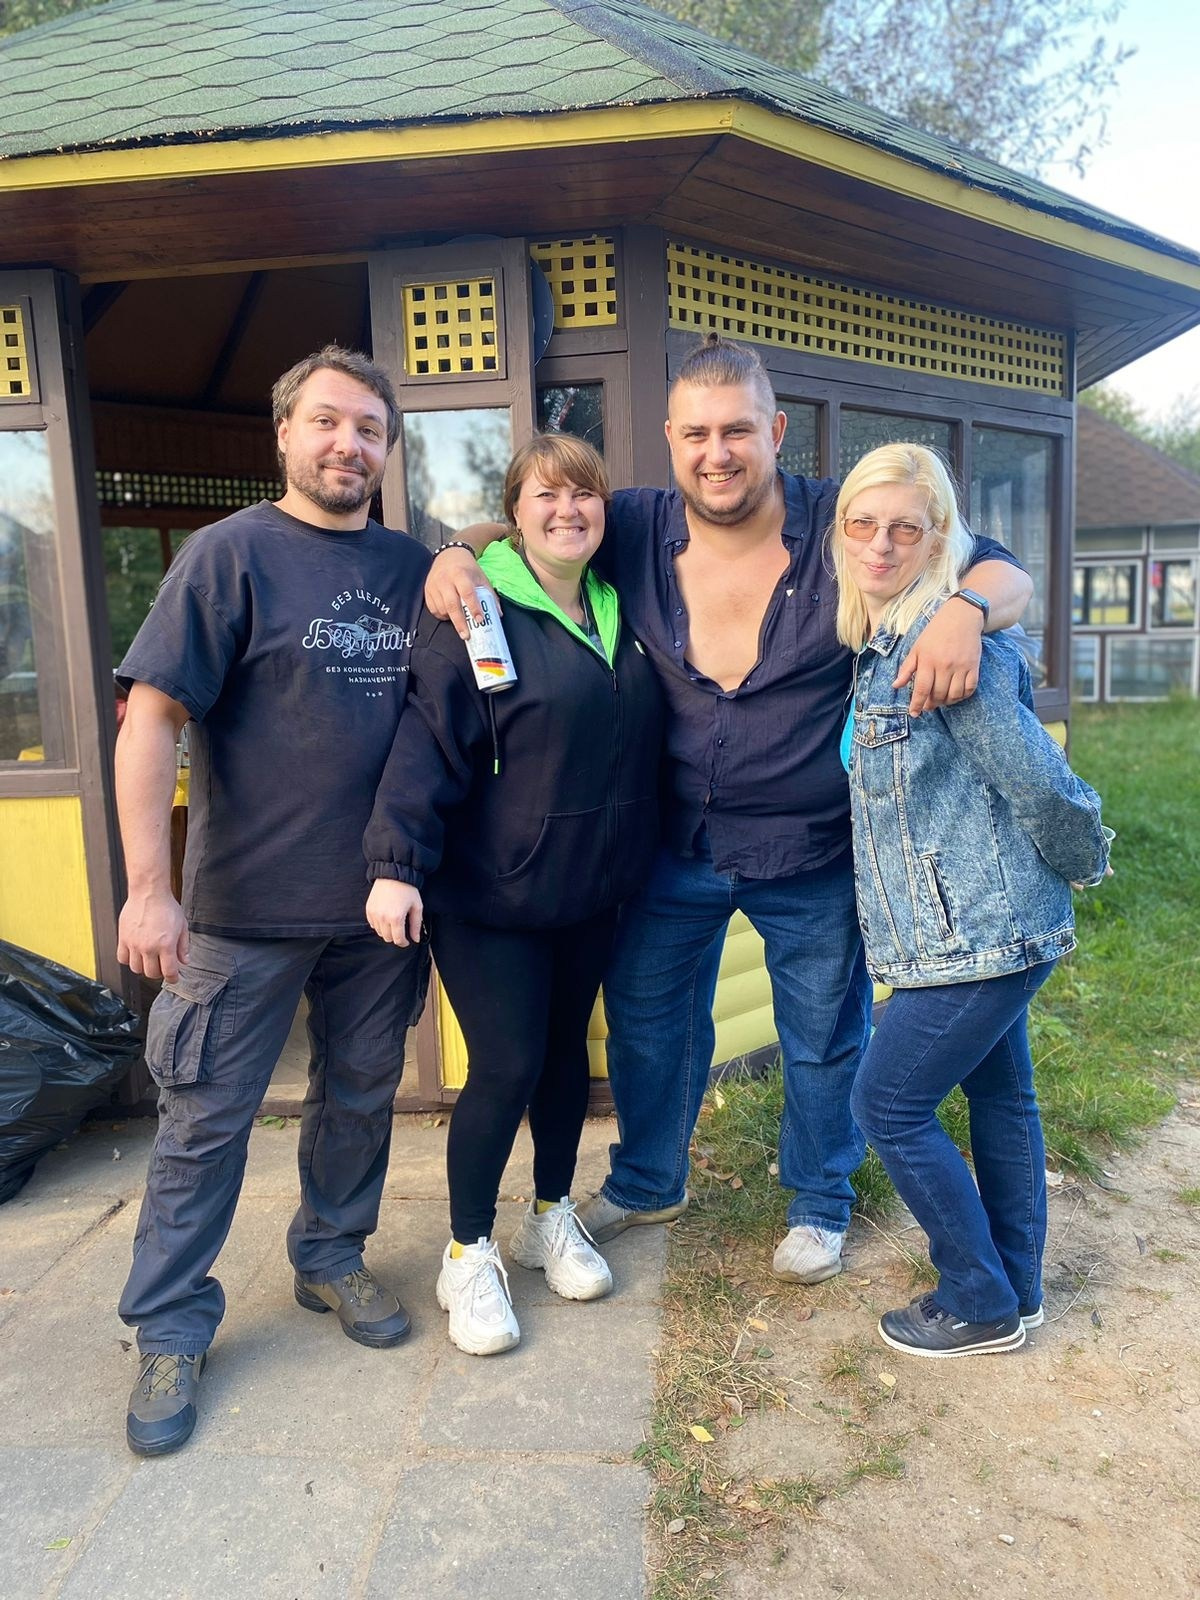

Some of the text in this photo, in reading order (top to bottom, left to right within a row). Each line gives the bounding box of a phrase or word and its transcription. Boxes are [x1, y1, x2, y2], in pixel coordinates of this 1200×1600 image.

[331, 589, 391, 615] БЕЗ ЦЕЛИ
[343, 666, 385, 674] КОНЕЧНОГО
